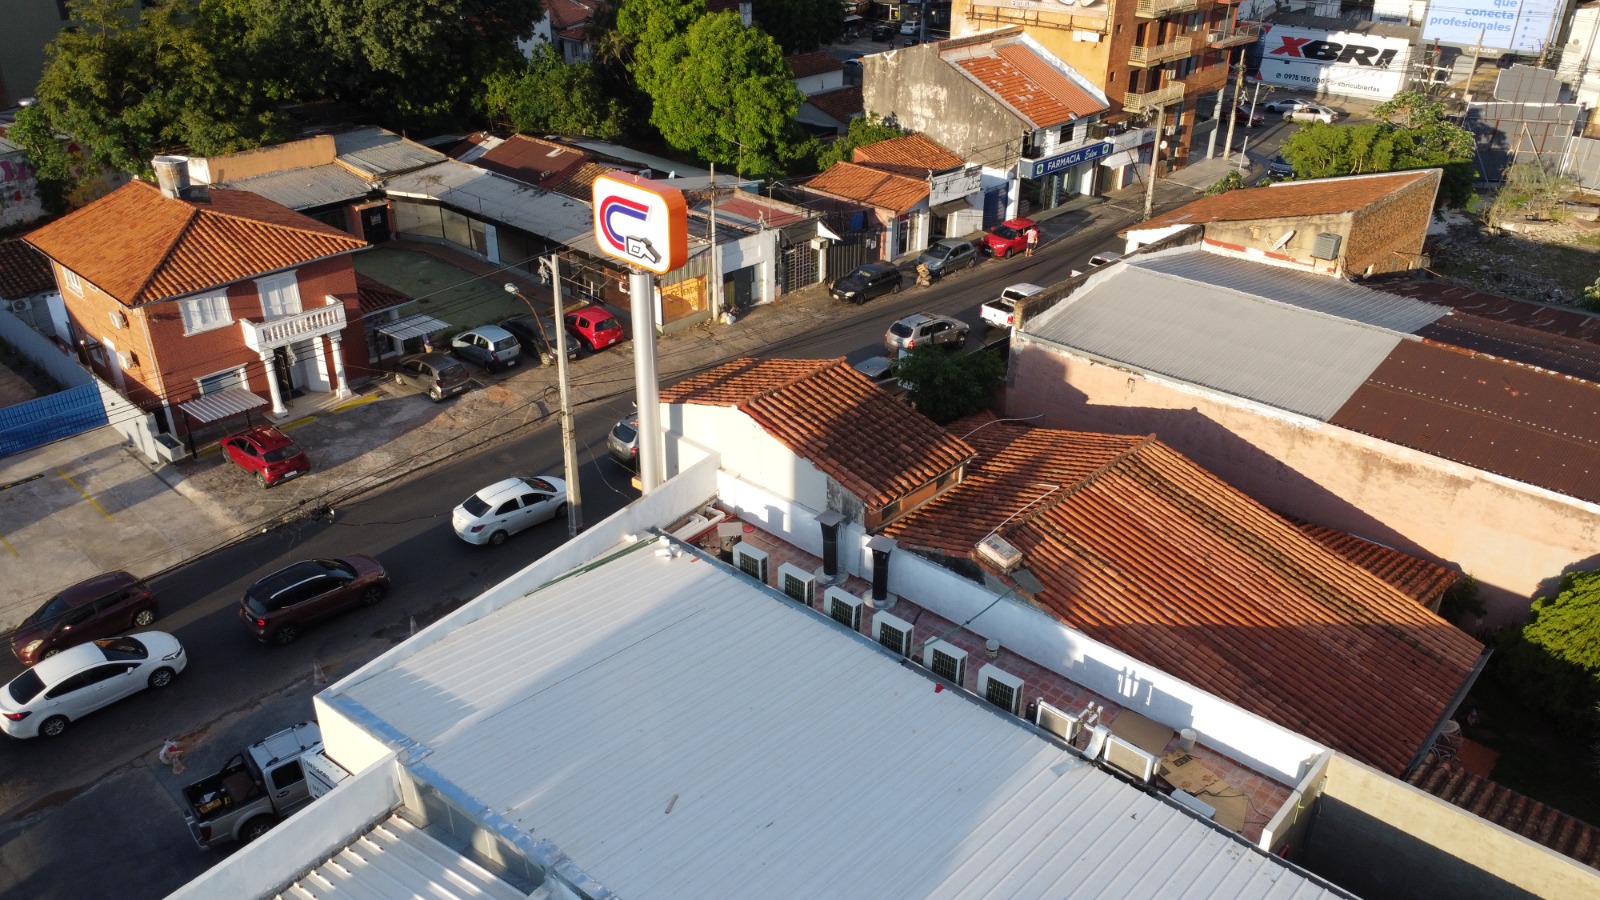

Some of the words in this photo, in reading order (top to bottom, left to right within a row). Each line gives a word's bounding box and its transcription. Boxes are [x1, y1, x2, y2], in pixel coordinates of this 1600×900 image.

[1494, 0, 1517, 9] que
[1465, 8, 1514, 20] conecta
[1430, 16, 1511, 32] profesionales
[1270, 36, 1398, 66] XBRI
[1284, 73, 1299, 81] 0975
[1047, 153, 1080, 171] FARMACIA
